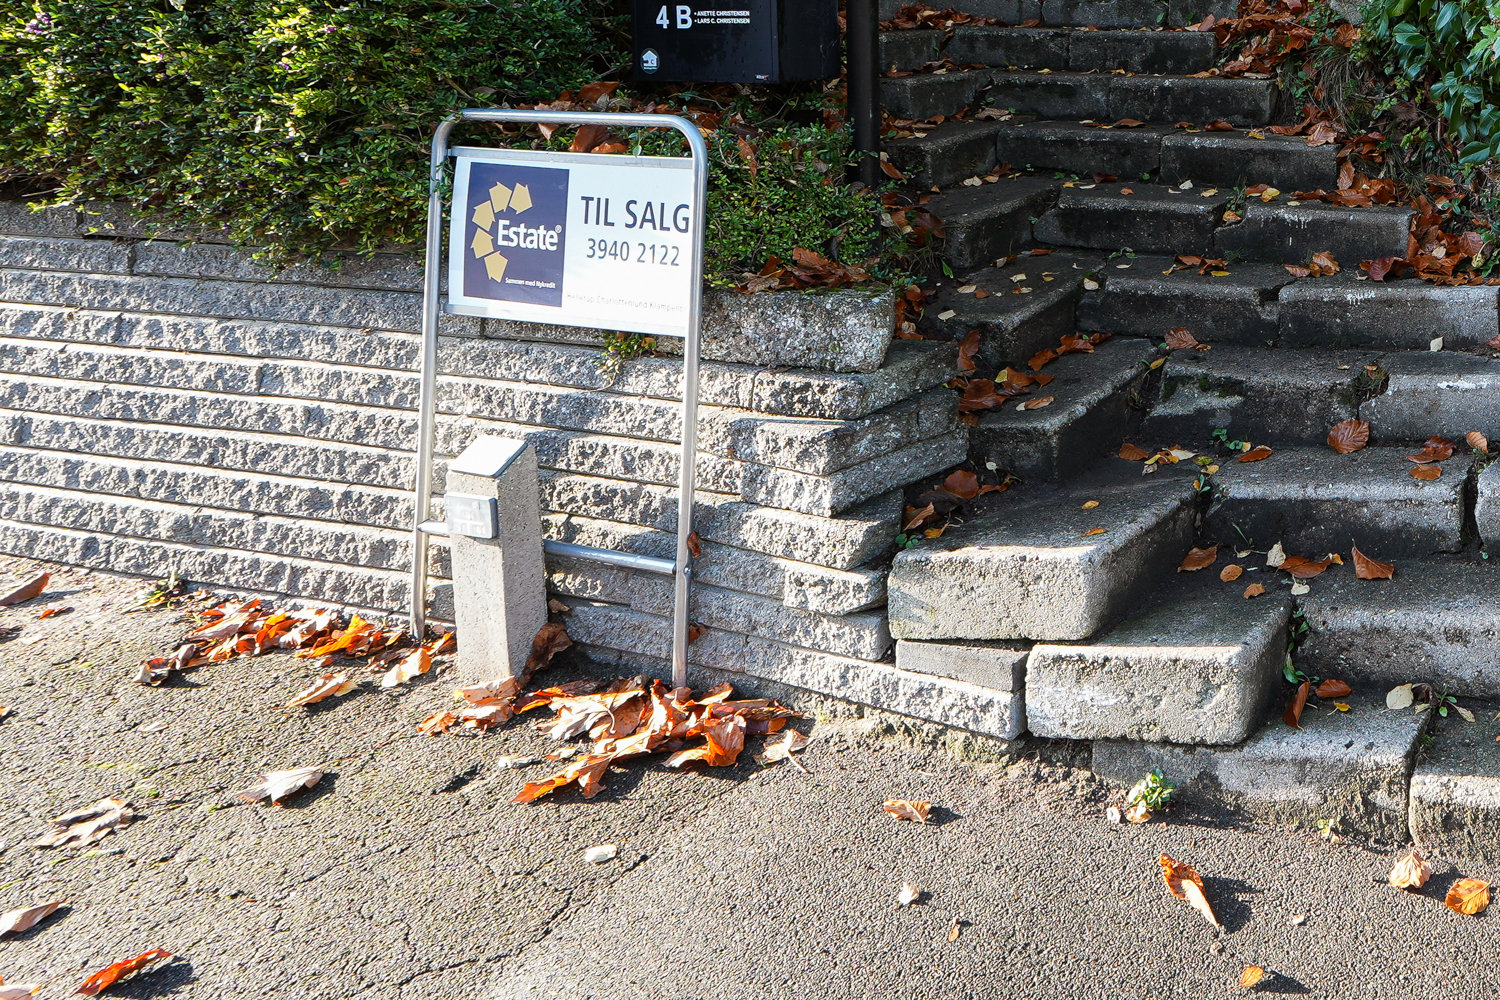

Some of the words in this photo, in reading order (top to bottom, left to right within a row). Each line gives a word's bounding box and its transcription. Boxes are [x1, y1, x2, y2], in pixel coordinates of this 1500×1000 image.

[656, 5, 669, 29] 4
[676, 5, 693, 29] B
[580, 196, 614, 227] TIL
[625, 200, 690, 233] SALG
[586, 238, 630, 261] 3940
[636, 243, 680, 266] 2122
[536, 280, 556, 289] Nykredit
